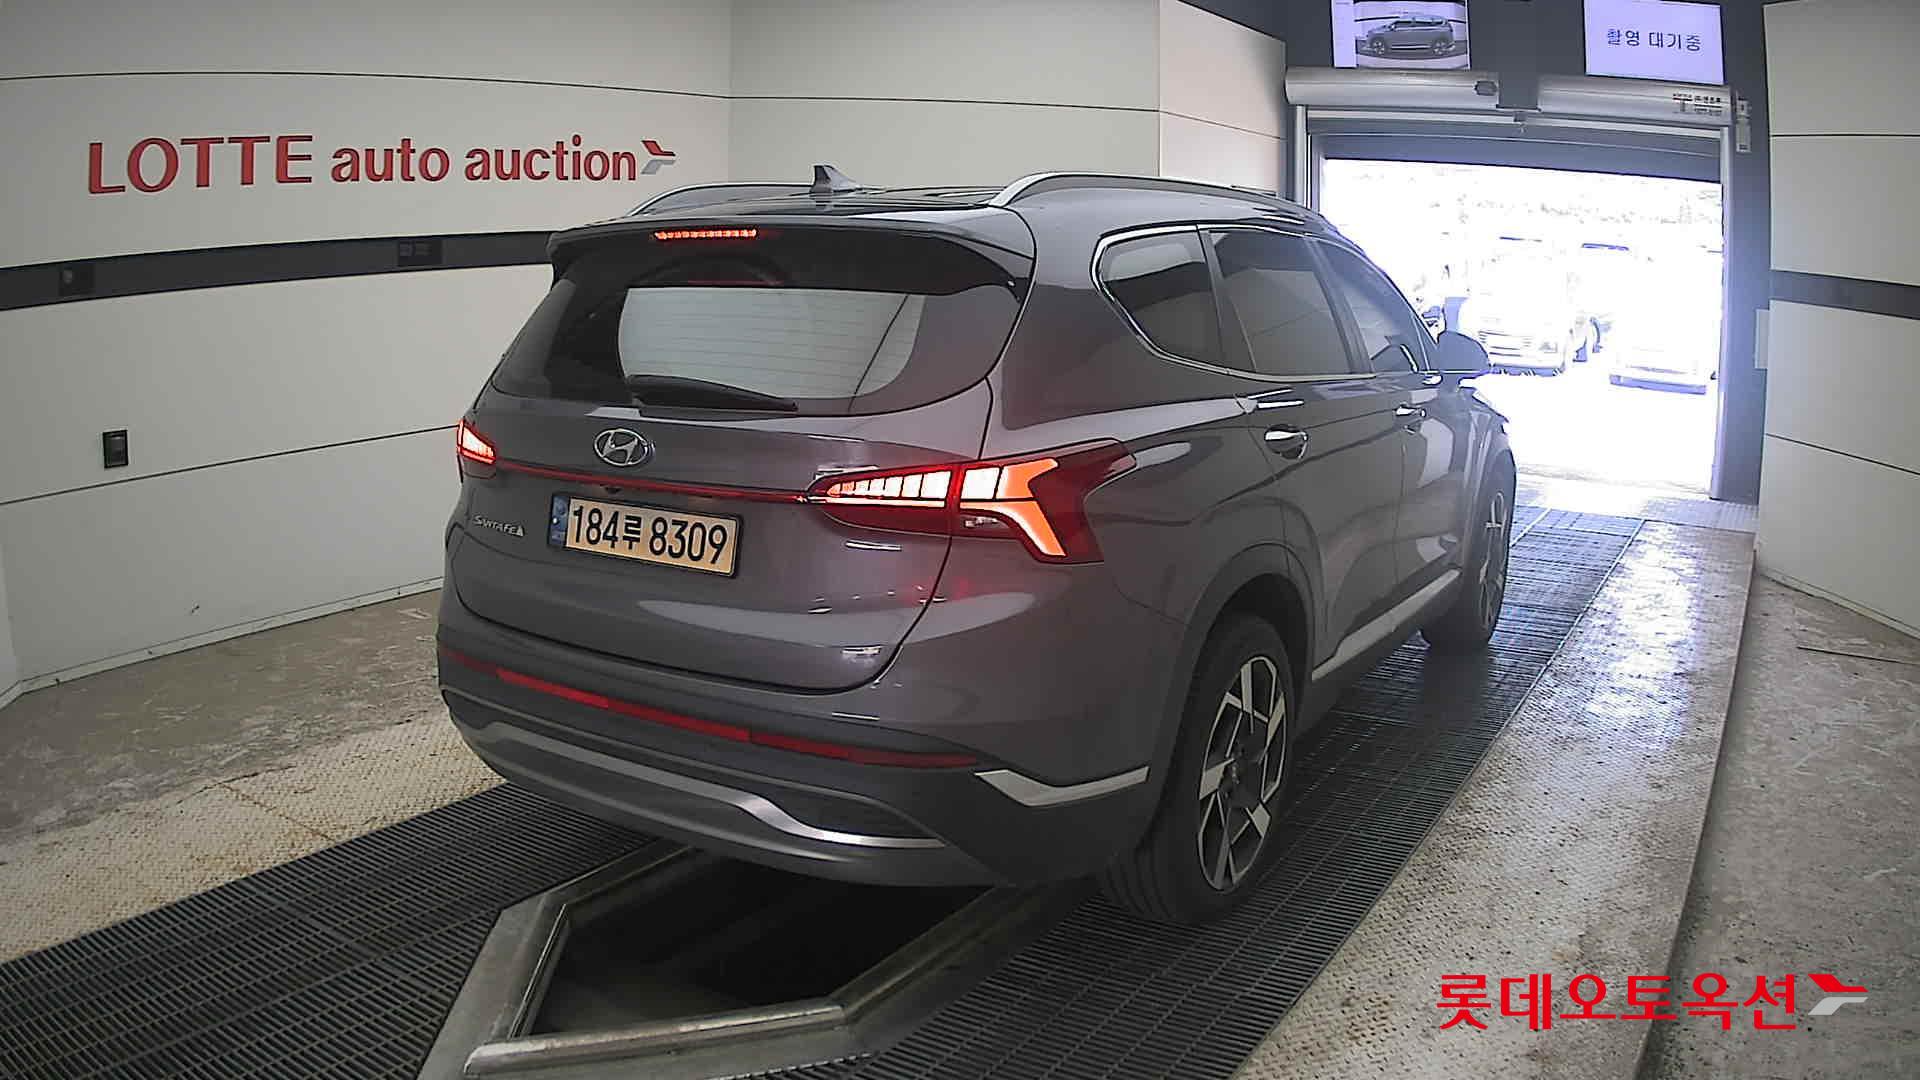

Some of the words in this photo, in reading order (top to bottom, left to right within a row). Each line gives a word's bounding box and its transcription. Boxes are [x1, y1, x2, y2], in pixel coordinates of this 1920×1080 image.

[1607, 28, 1640, 47] 촬영
[1648, 31, 1701, 52] 대기중
[89, 135, 313, 194] LOTTE
[331, 138, 450, 183] auto
[465, 134, 637, 181] auction
[572, 504, 643, 551] 184루
[649, 516, 728, 565] 8309
